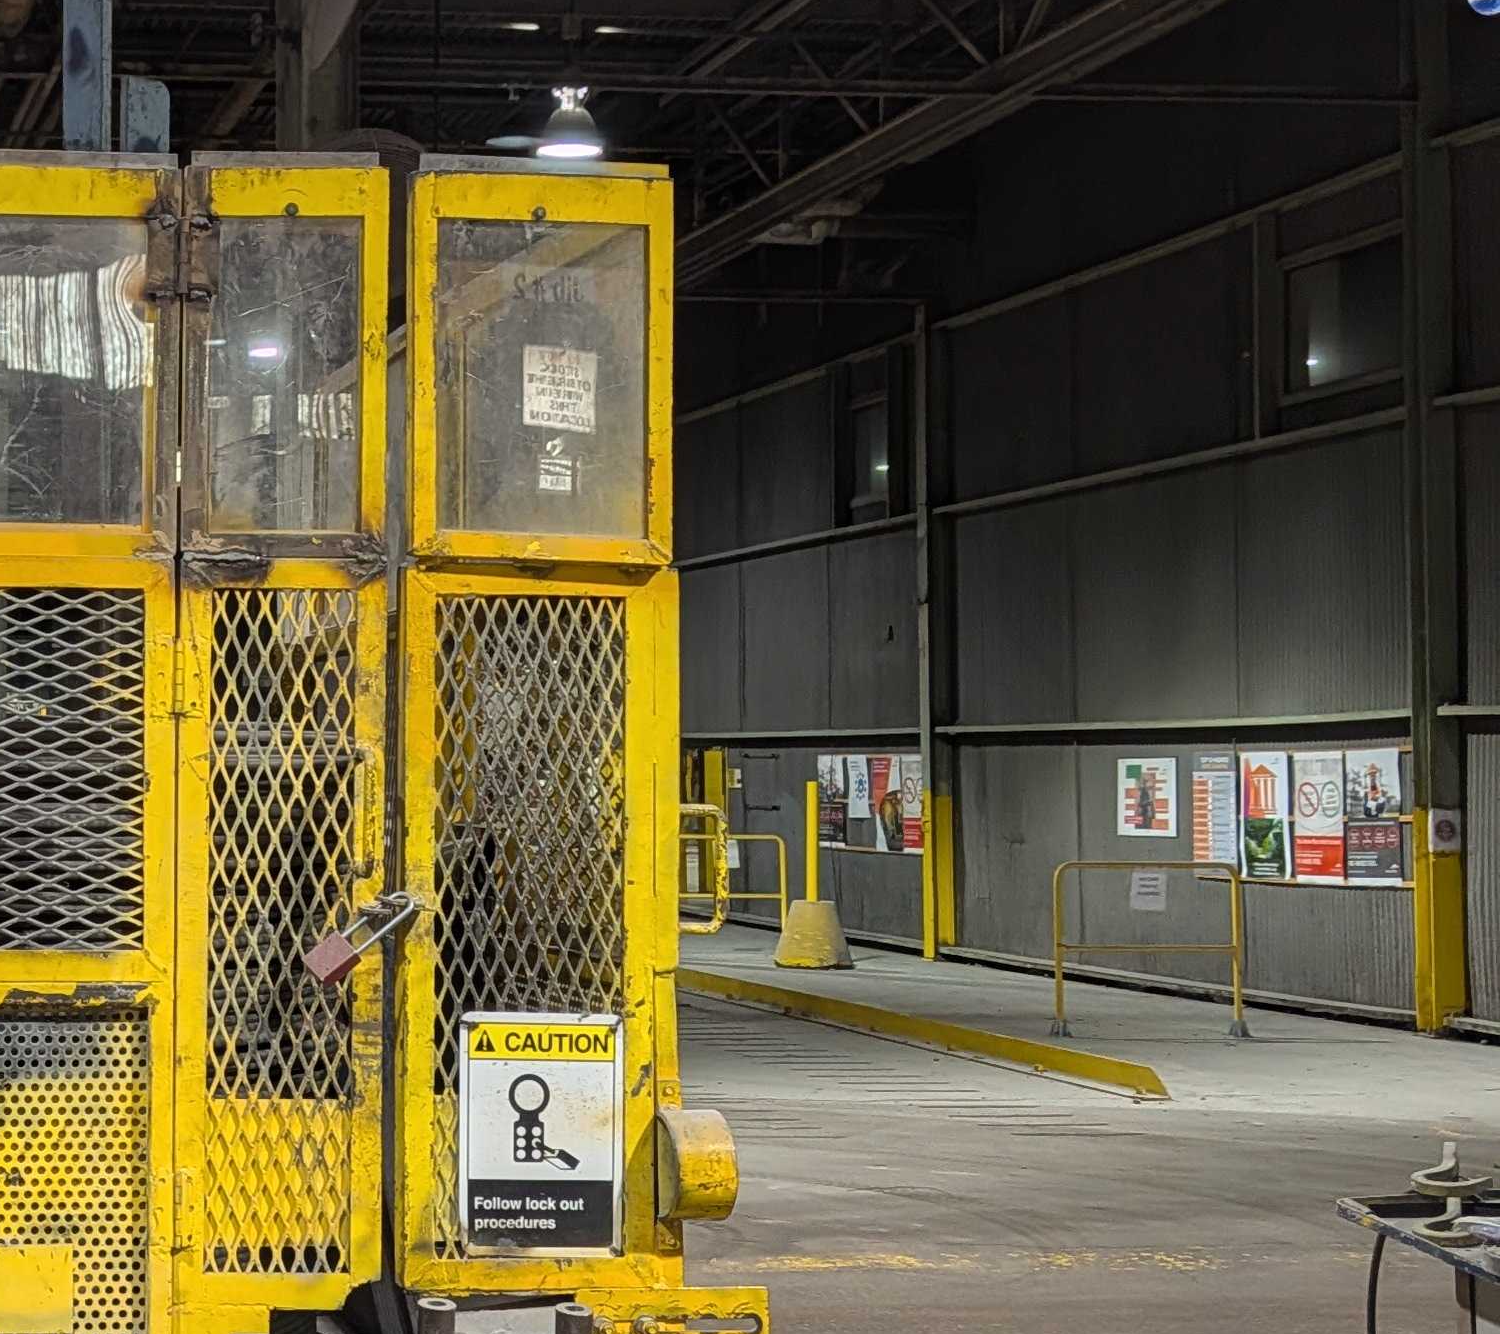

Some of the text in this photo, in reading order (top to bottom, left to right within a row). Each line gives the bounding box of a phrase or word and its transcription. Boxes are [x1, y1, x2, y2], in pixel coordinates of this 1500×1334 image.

[504, 1032, 609, 1054] CAUTION
[474, 1196, 585, 1211] Follow lock out
[474, 1216, 557, 1231] procedures
